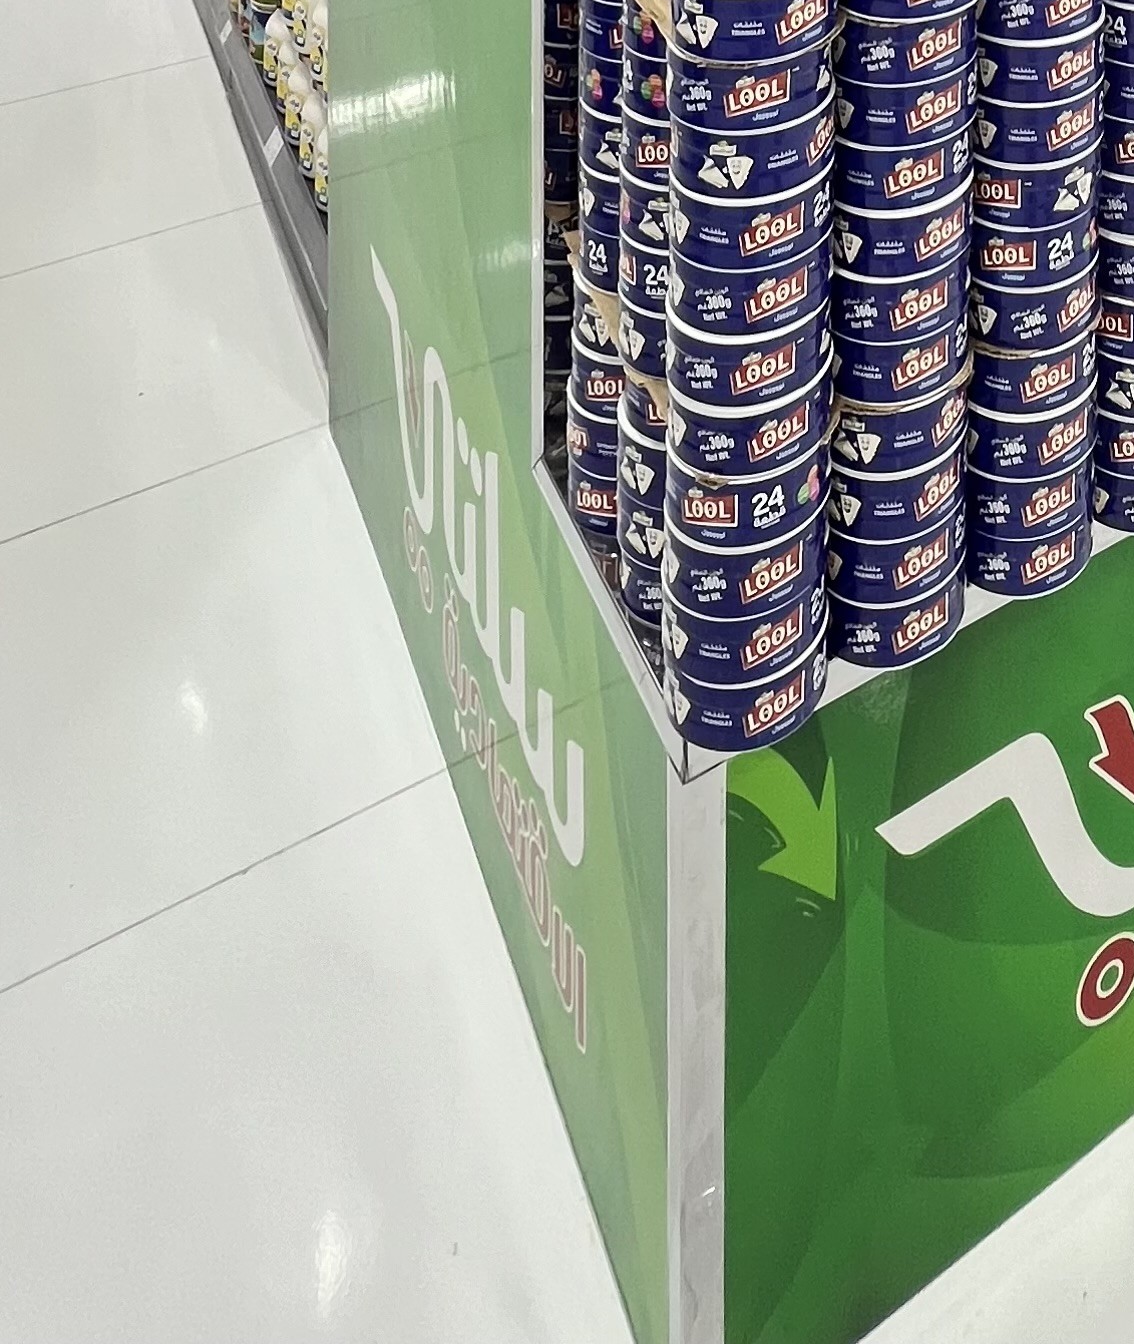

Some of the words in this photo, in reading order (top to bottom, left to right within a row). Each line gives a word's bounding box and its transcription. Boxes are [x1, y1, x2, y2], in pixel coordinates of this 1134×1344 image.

[729, 81, 784, 111] LOOL
[744, 213, 798, 250] LOOL
[1048, 232, 1073, 257] 24
[985, 248, 1030, 266] LOOL
[894, 289, 944, 324] LOOL
[685, 501, 731, 519] LOOL
[753, 485, 785, 514] 24
[744, 556, 797, 597] LOOL
[898, 547, 944, 582] LOOL
[1025, 546, 1071, 577] LOOL
